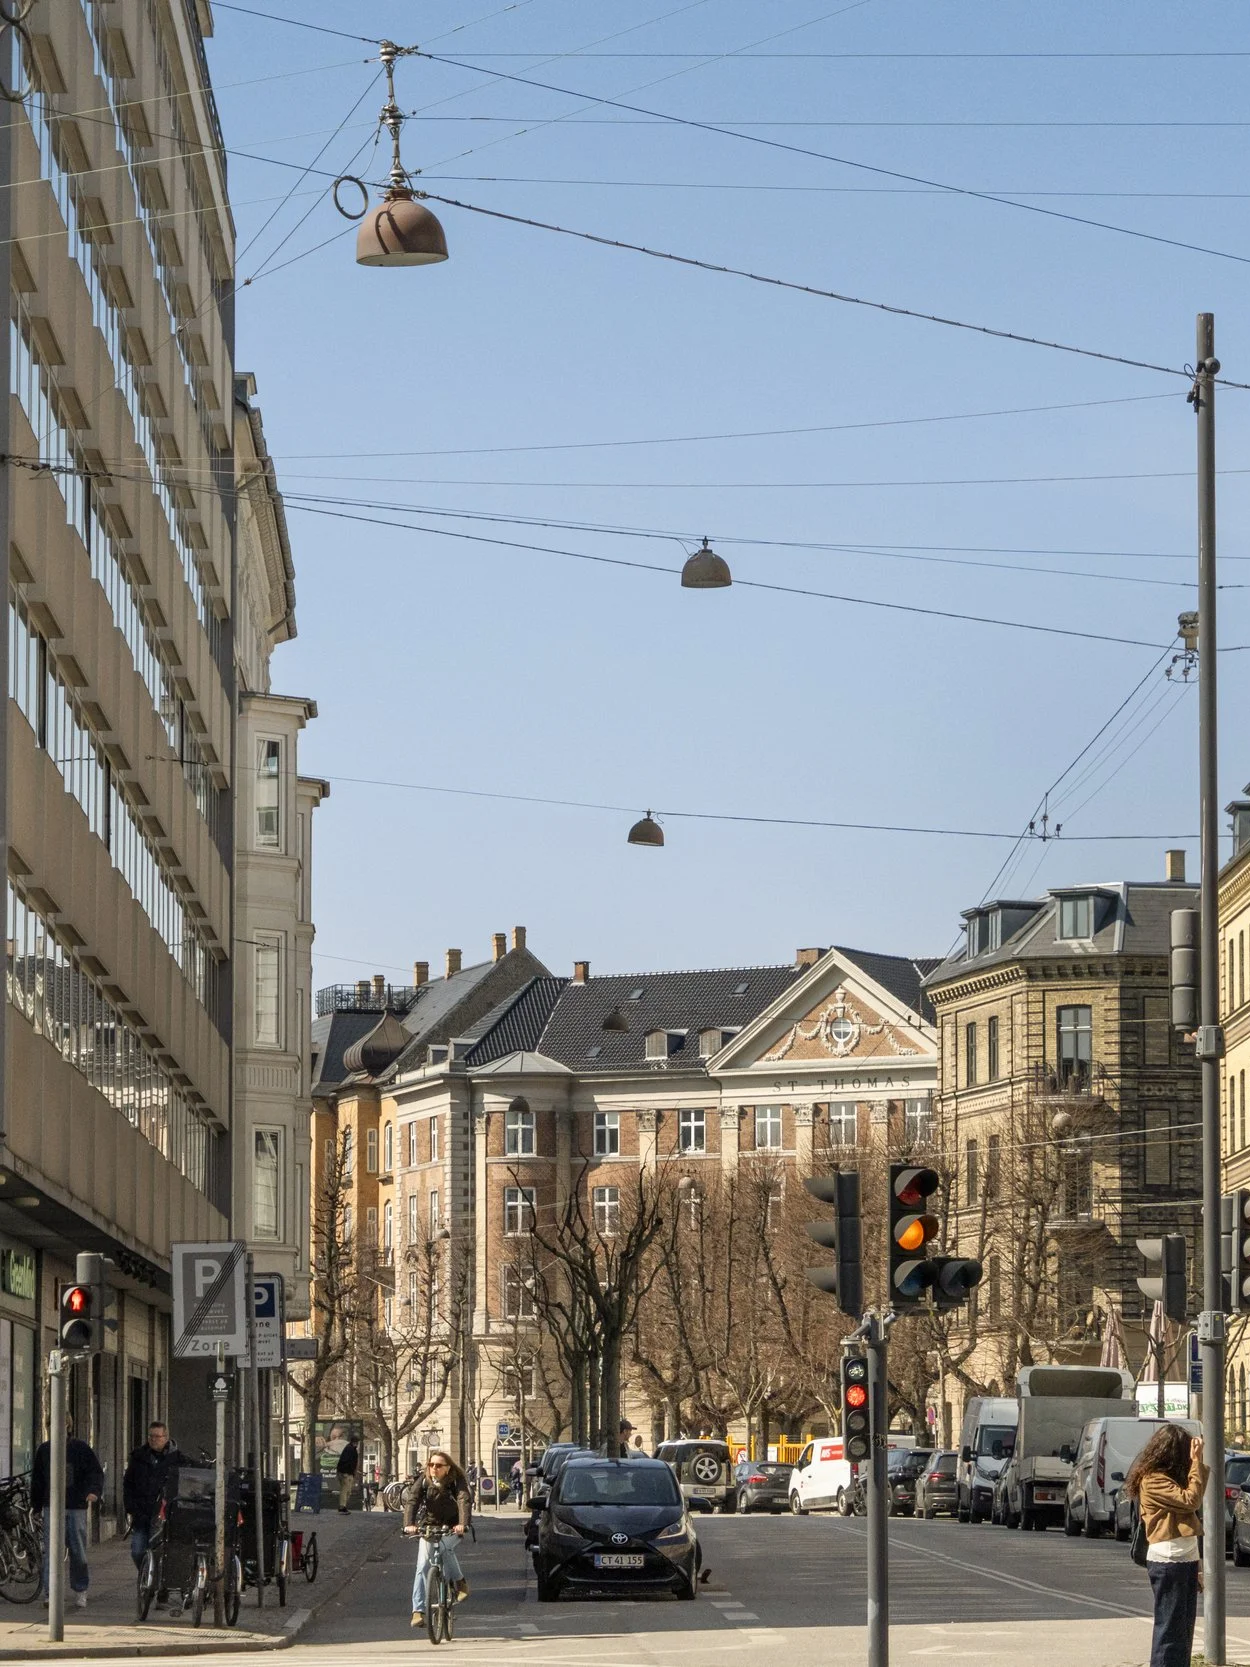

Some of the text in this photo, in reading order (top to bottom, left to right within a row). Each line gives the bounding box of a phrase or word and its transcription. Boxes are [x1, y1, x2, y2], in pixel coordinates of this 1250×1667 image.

[194, 1259, 222, 1297] P
[499, 1425, 508, 1433] 40
[601, 1556, 643, 1565] CT 41 155
